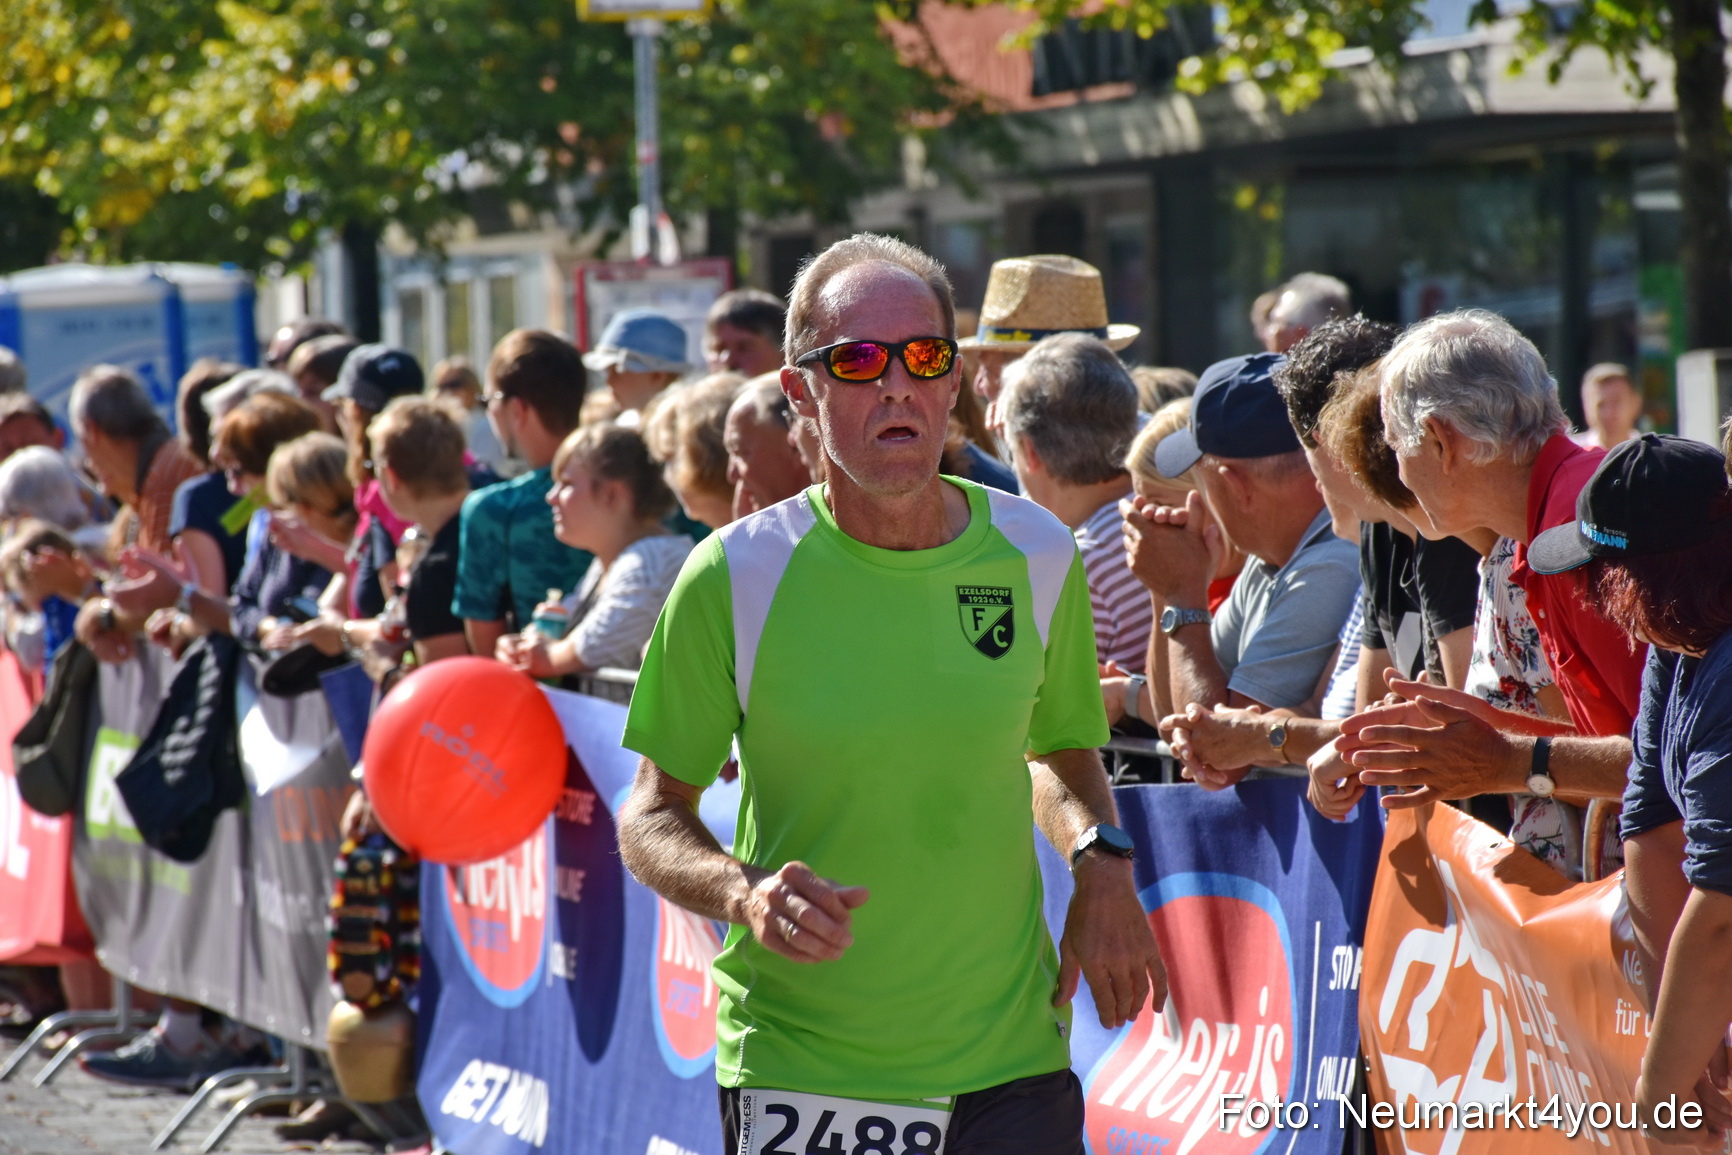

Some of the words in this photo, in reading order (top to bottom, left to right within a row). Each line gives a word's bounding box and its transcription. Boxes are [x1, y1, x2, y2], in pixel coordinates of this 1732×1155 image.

[958, 588, 1010, 597] EZELSDORF
[967, 596, 988, 604] 1923
[971, 607, 986, 632] F
[992, 624, 1009, 648] C
[1615, 998, 1641, 1037] für
[760, 1102, 943, 1155] 2488
